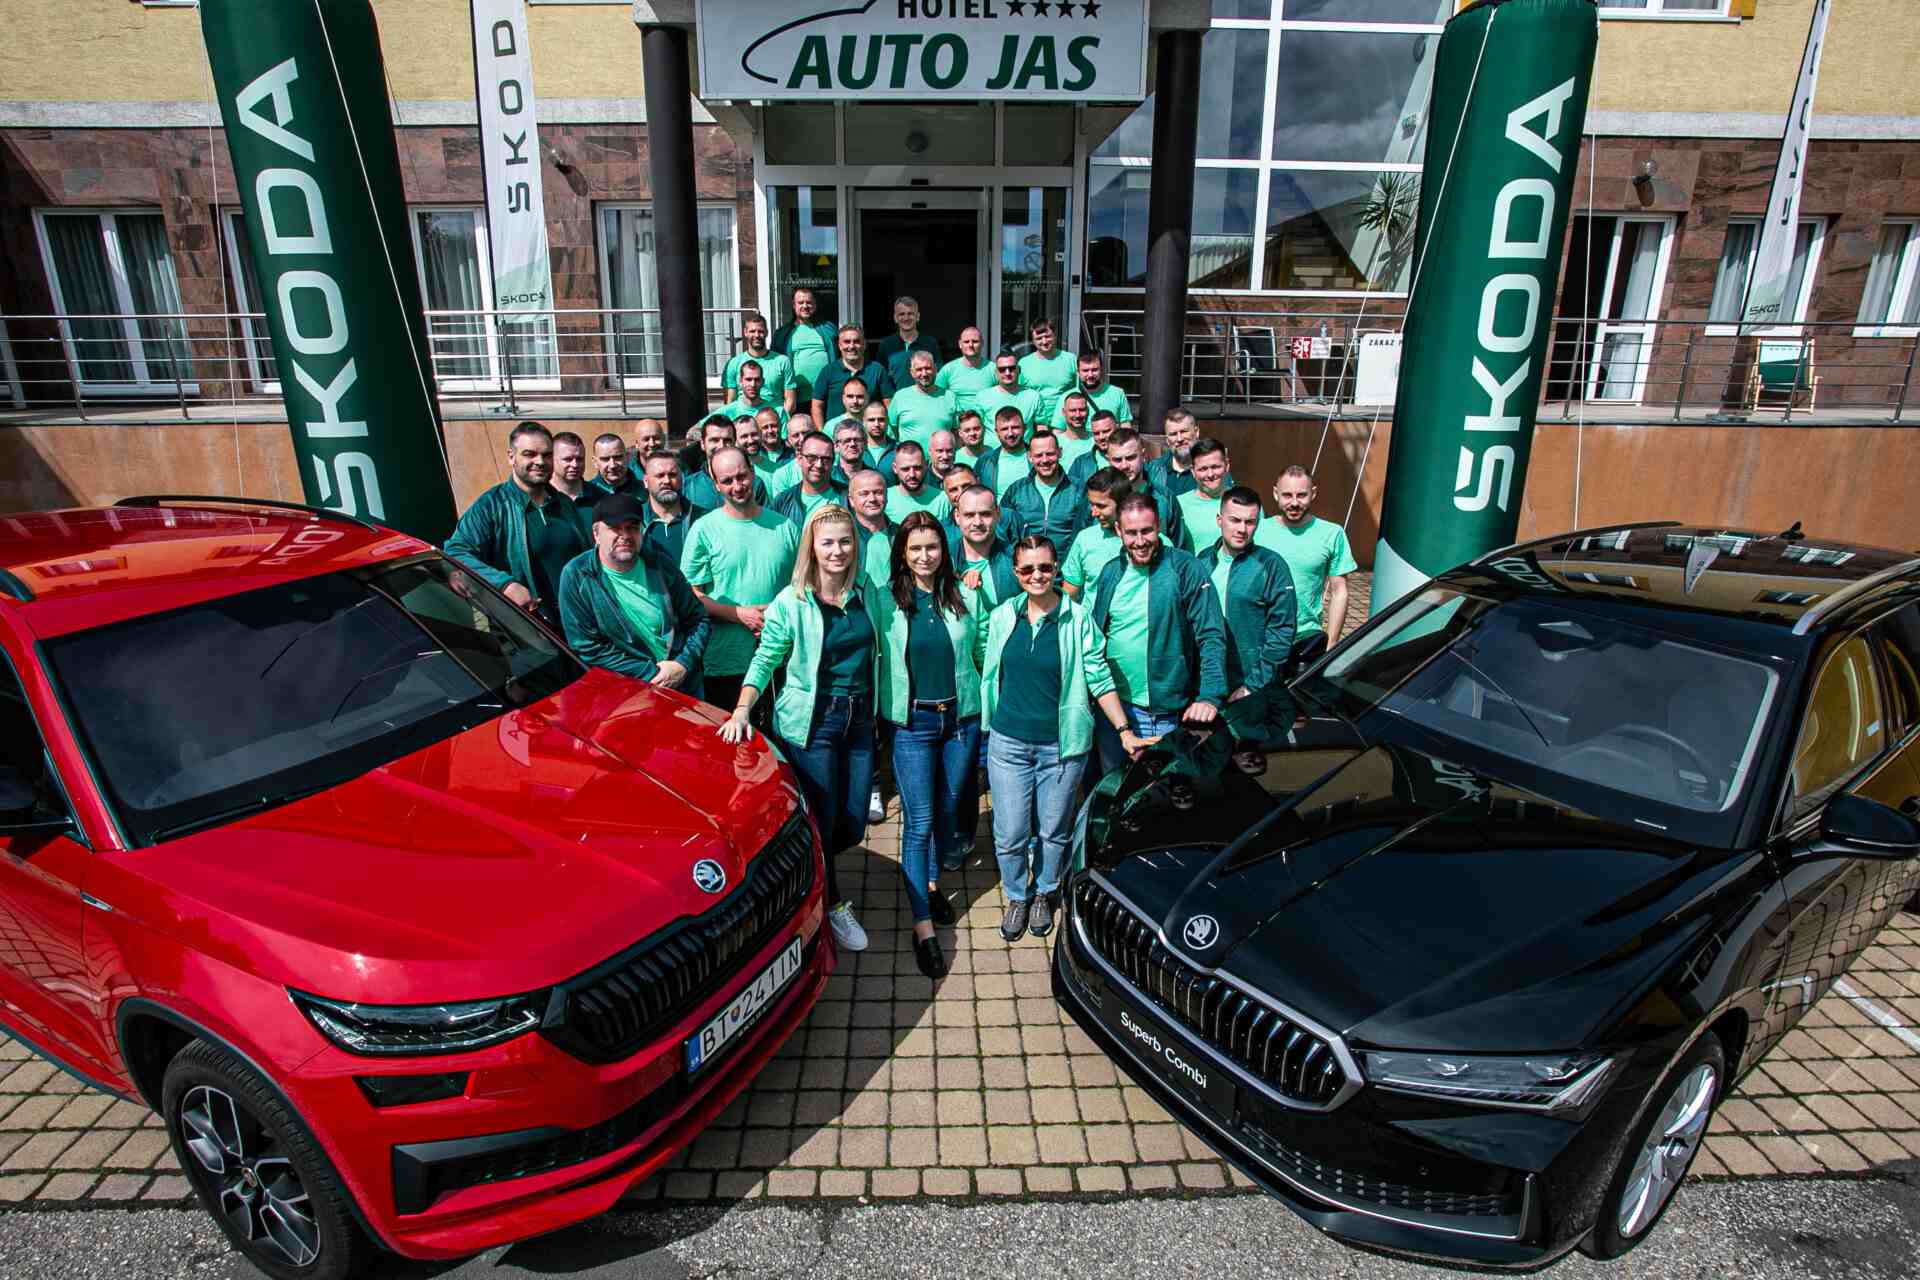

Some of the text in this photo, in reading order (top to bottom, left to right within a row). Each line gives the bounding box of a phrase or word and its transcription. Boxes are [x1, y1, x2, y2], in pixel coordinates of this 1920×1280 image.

[897, 0, 998, 19] HOTEL
[786, 33, 1101, 92] AUTO JAS
[703, 1011, 729, 1054] BT
[1121, 1012, 1207, 1089] Superb Combi
